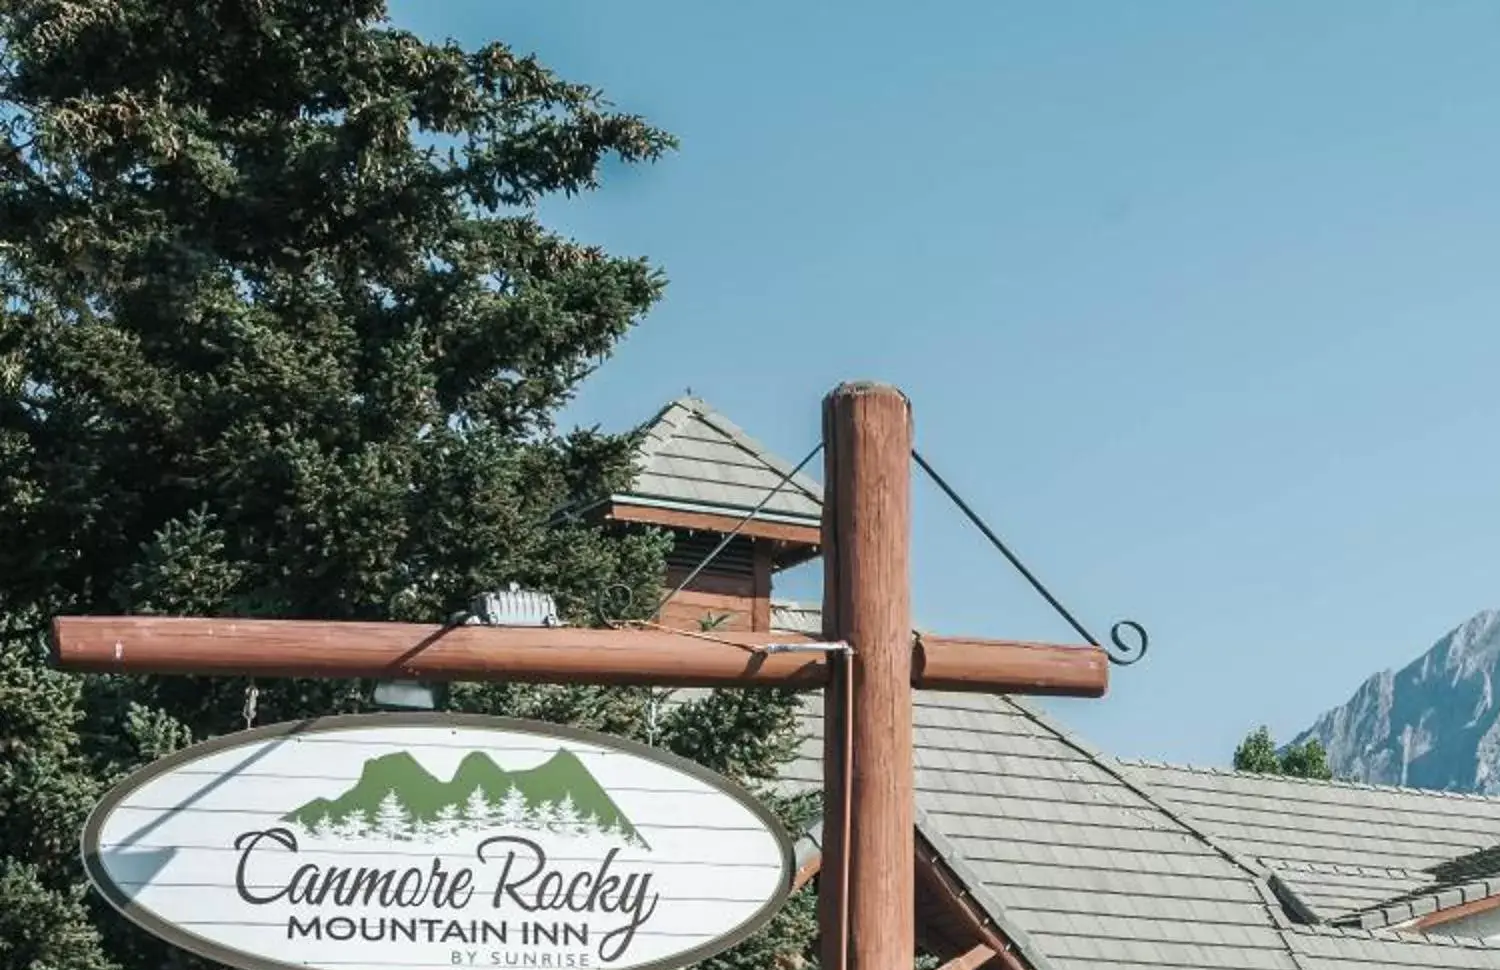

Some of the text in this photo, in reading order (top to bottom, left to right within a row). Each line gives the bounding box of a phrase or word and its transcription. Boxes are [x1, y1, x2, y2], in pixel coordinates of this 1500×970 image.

[233, 827, 659, 962] Canmore Rocky
[287, 915, 588, 946] MOUNTAIN INN
[450, 951, 589, 967] BY SUNRISE
